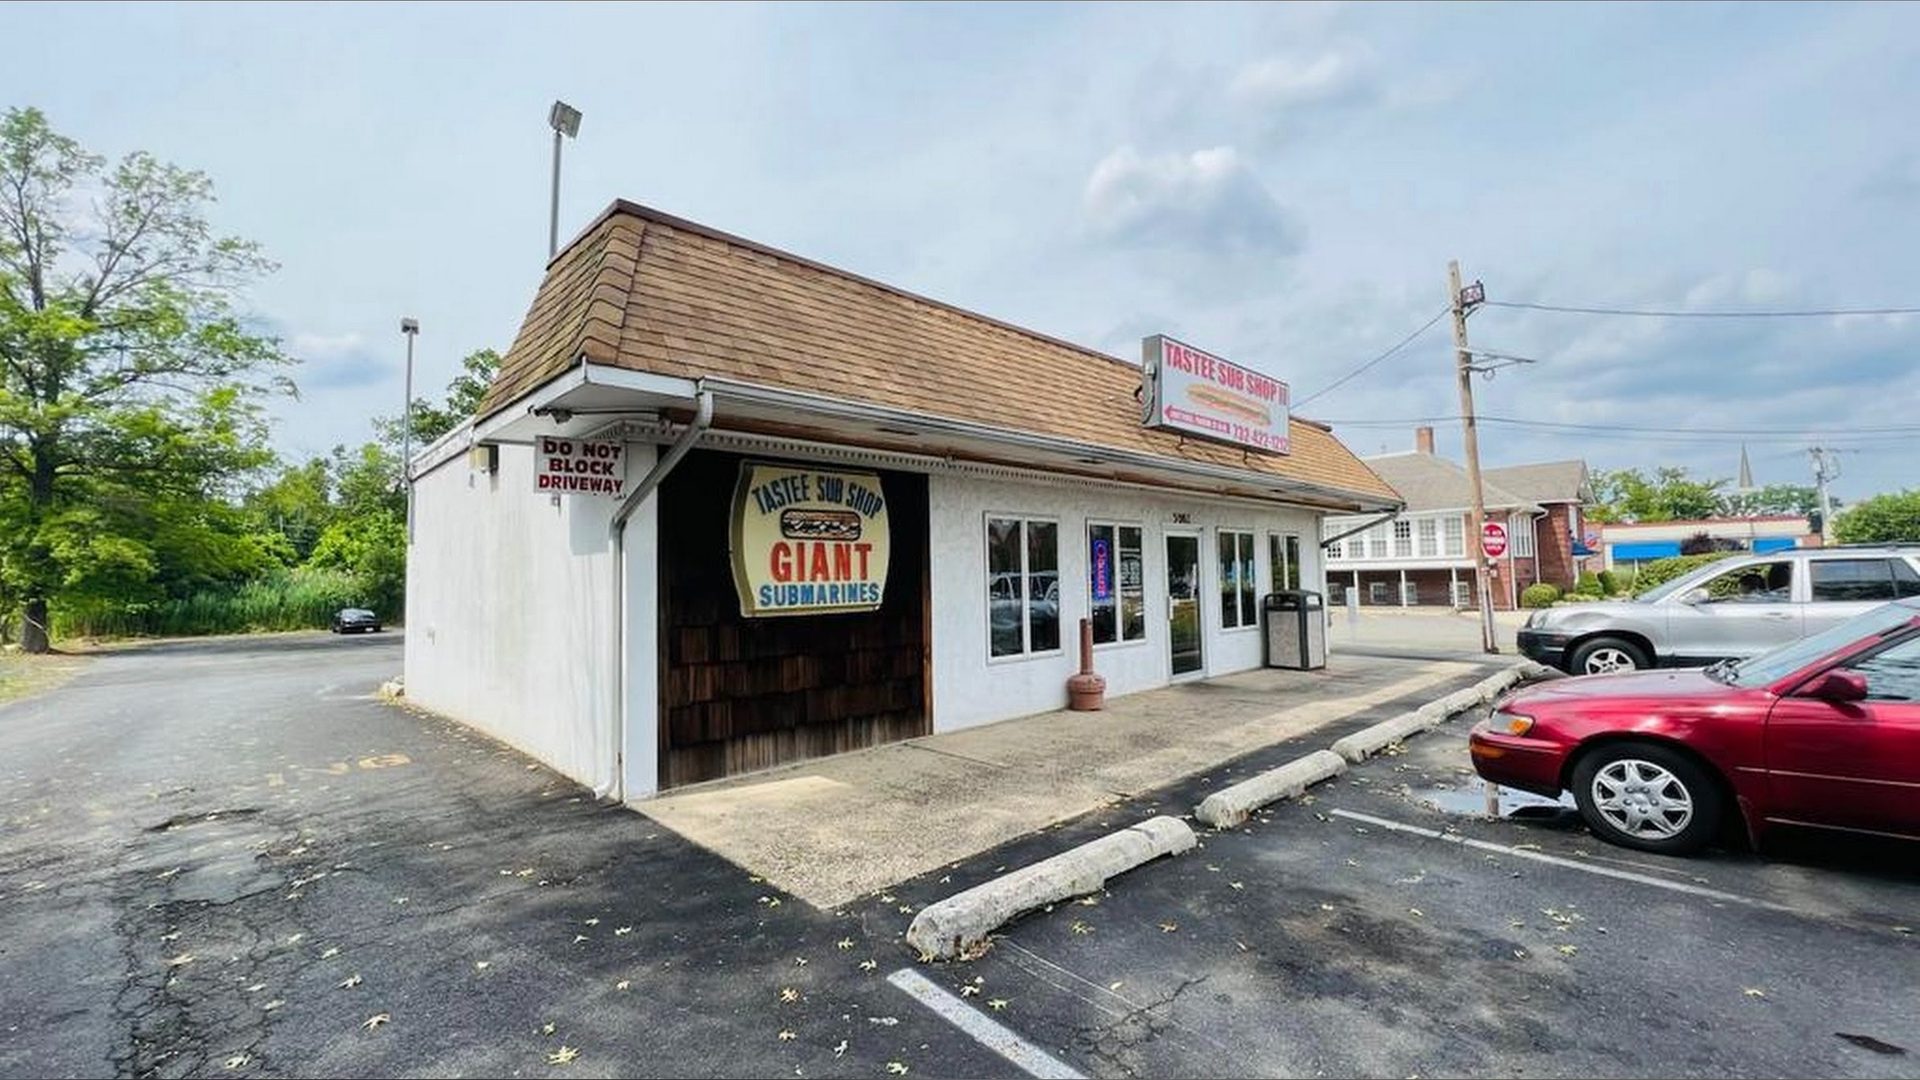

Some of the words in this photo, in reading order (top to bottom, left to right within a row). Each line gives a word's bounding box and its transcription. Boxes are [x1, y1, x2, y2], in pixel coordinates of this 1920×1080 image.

[1164, 341, 1215, 381] TASTEE
[1218, 362, 1244, 391] SUB
[1246, 373, 1277, 402] SHOP
[543, 440, 573, 456] DO
[583, 443, 622, 459] NOT
[549, 458, 615, 476] BLOCK
[539, 475, 624, 495] DRIVEWAY
[751, 475, 811, 515] TASTEE
[816, 476, 844, 504] SUB
[846, 483, 883, 519] SHOP
[770, 541, 873, 583] GIANT
[760, 582, 880, 607] SUBMARINES
